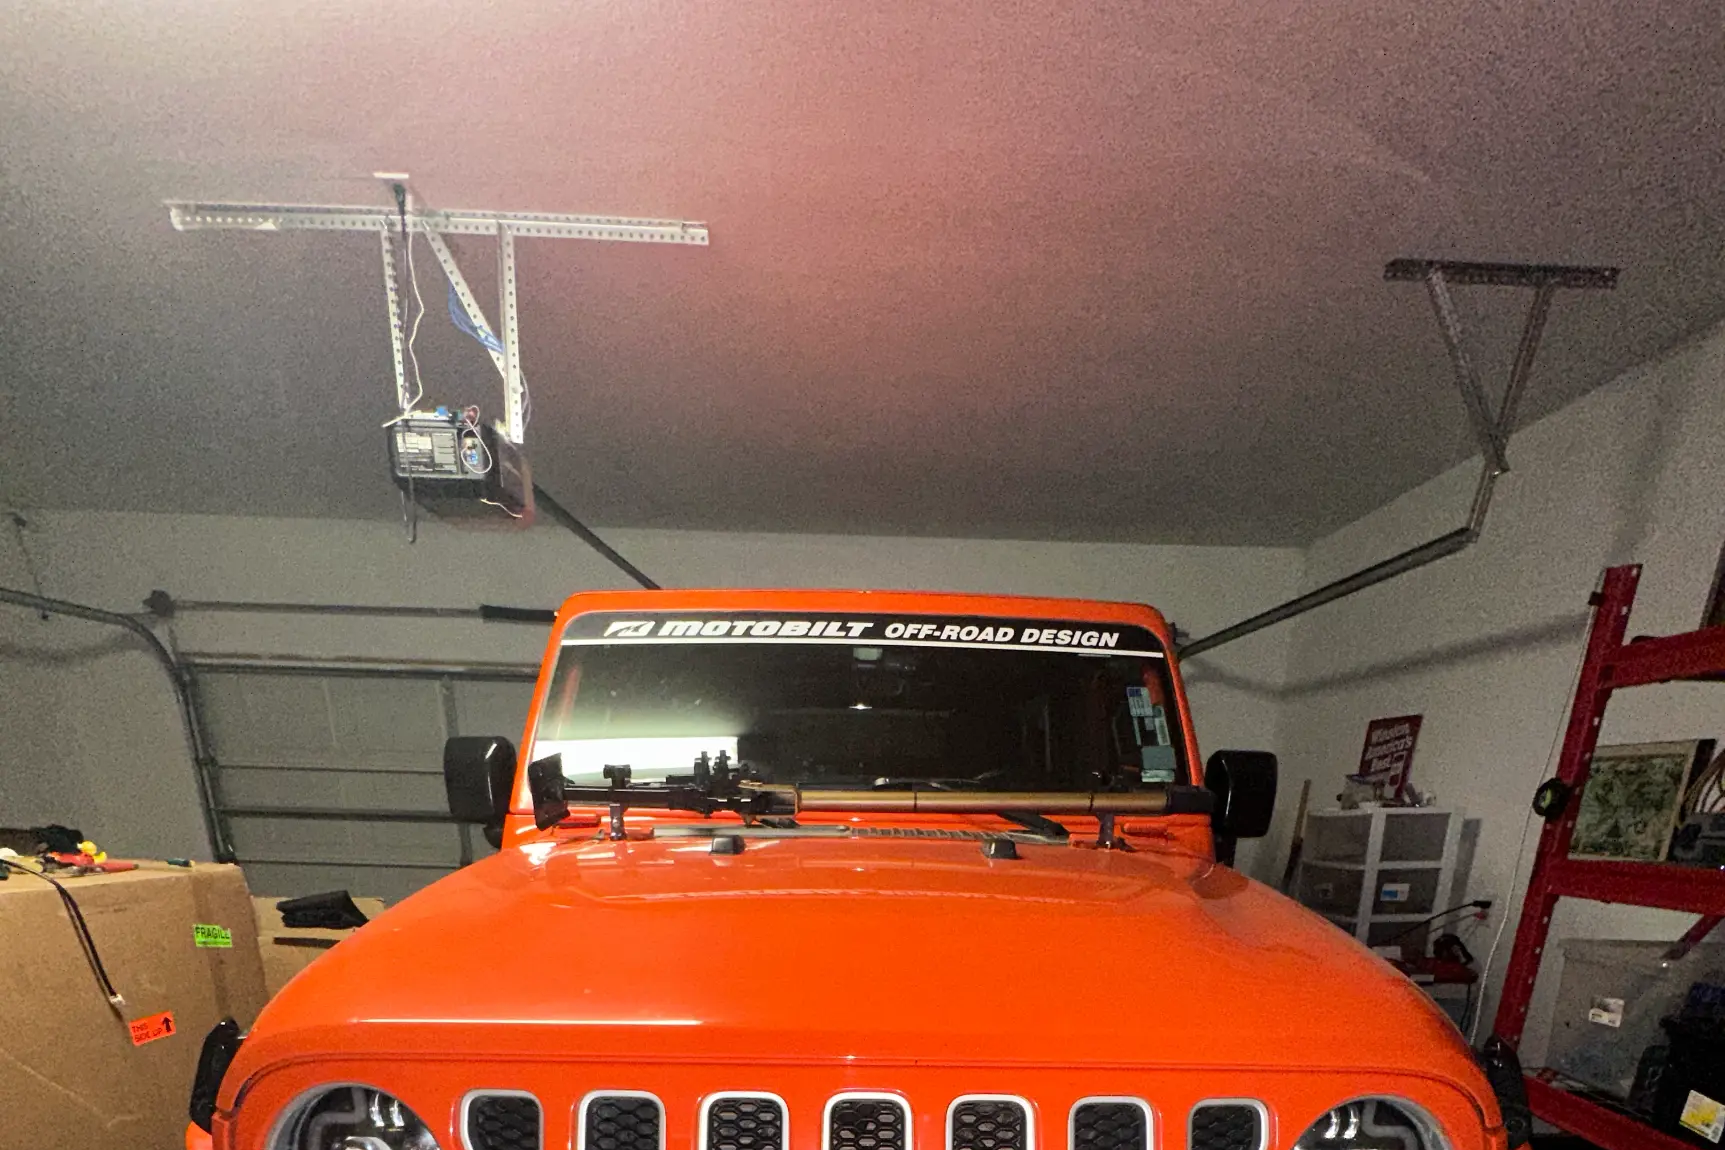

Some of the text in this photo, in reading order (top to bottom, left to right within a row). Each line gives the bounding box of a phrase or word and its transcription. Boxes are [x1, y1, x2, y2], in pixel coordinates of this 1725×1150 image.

[657, 620, 1120, 648] MOTOBILT OFF-ROAD DESIGN
